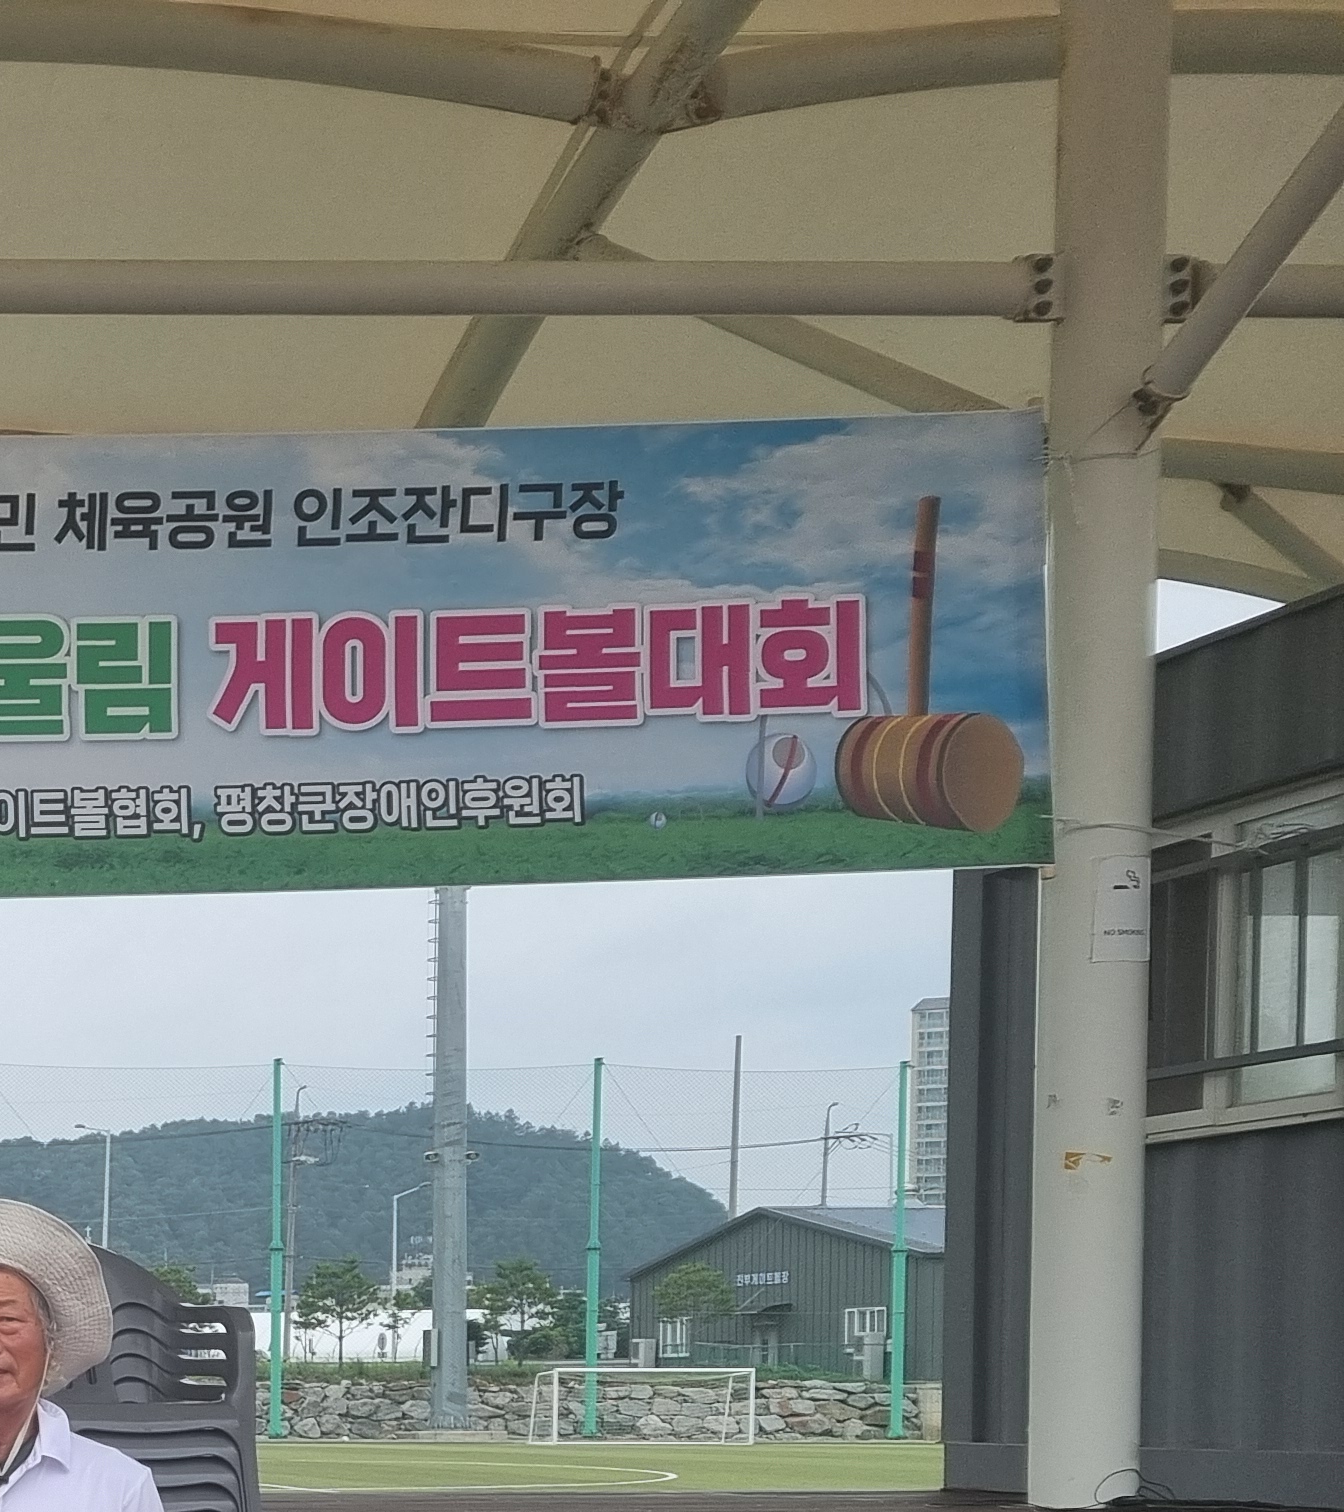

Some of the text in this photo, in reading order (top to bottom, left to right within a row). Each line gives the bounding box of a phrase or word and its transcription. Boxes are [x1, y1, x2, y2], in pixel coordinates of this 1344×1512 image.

[53, 488, 274, 552] 체육공원
[293, 480, 625, 545] 인조잔디구장
[208, 592, 868, 736] 게이트볼대회
[214, 774, 585, 835] 평창군장애인후원회
